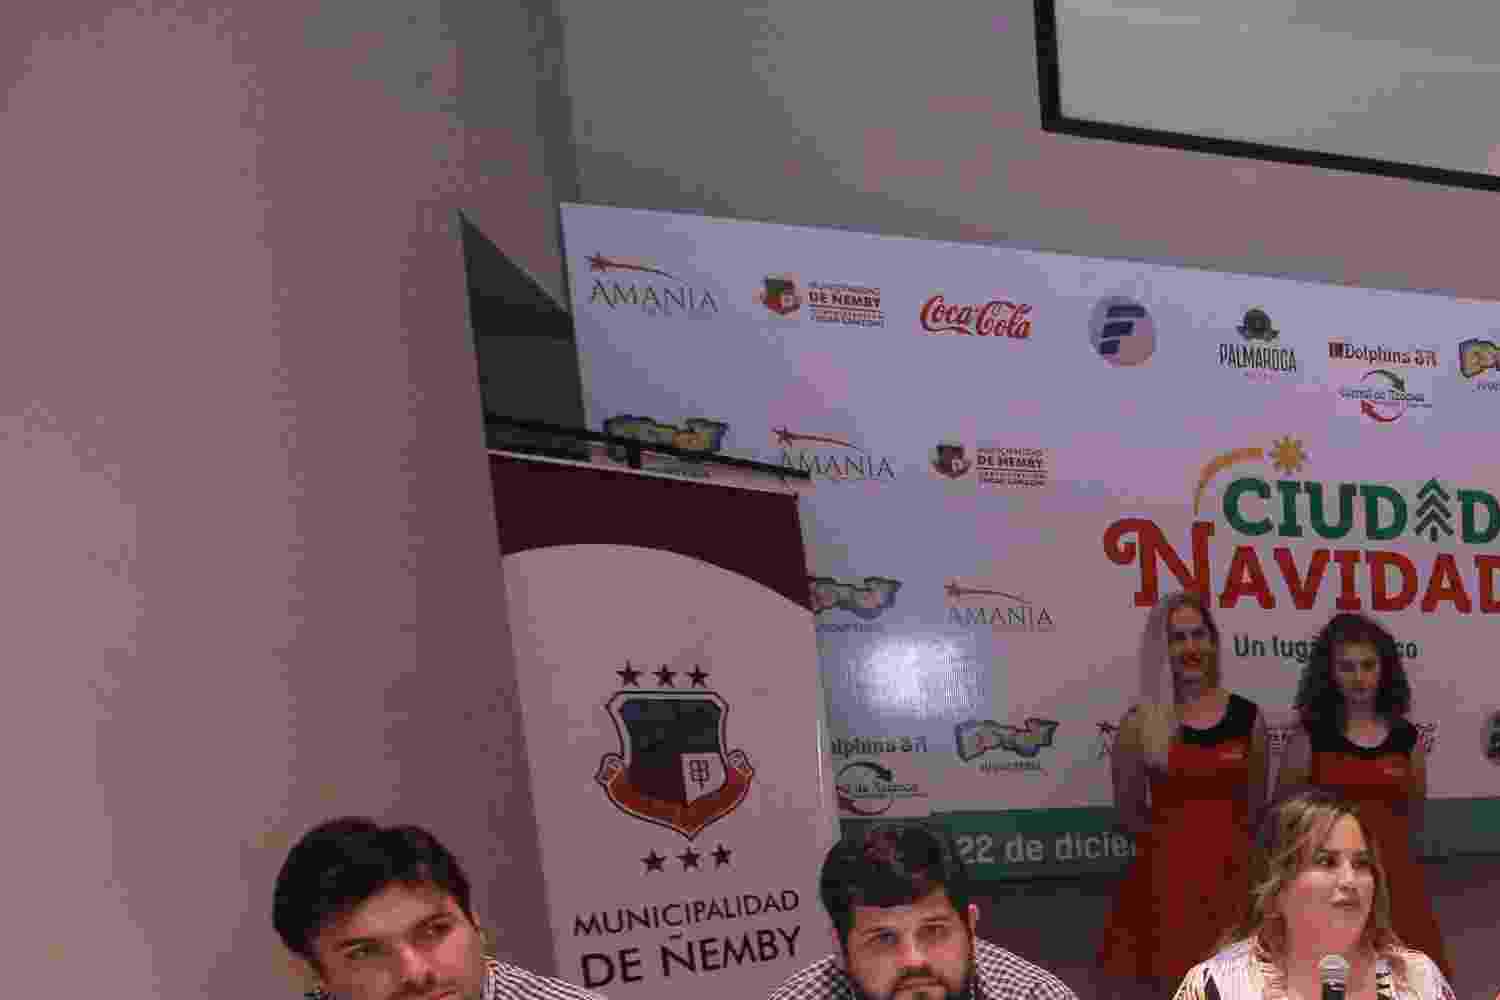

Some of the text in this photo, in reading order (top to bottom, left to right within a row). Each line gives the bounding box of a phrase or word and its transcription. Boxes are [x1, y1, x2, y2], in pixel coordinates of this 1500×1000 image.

[1235, 635, 1264, 658] Un
[1005, 832, 1046, 863] de
[1055, 832, 1137, 860] dicie
[573, 889, 800, 937] MUNICIPALIDAD
[581, 926, 801, 990] DE ÑEMBY
